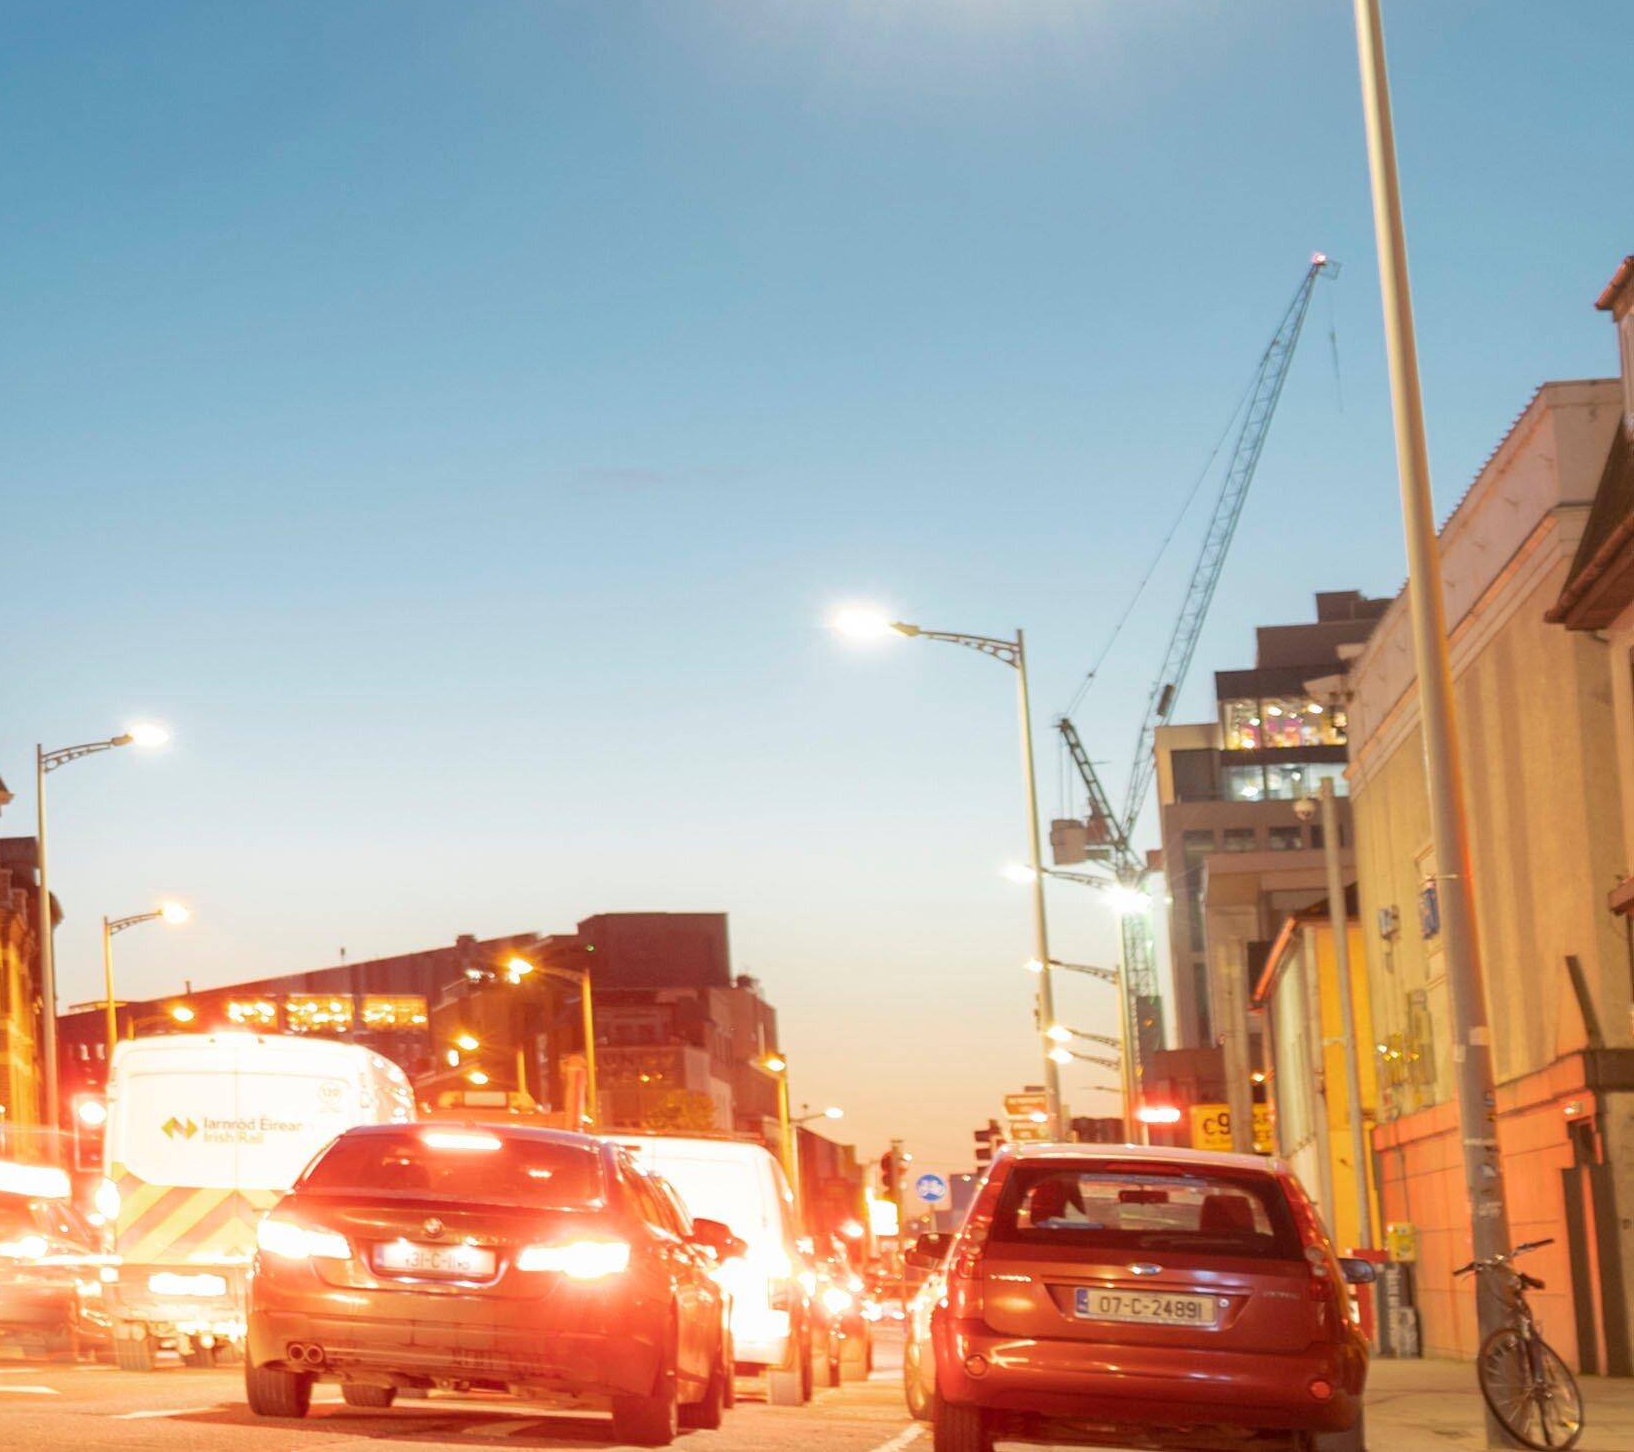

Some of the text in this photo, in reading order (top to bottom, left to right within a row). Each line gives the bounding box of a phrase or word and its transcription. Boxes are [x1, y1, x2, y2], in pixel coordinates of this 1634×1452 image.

[203, 1132, 264, 1144] Irish Rail
[1100, 1296, 1203, 1320] 07-C-24891
